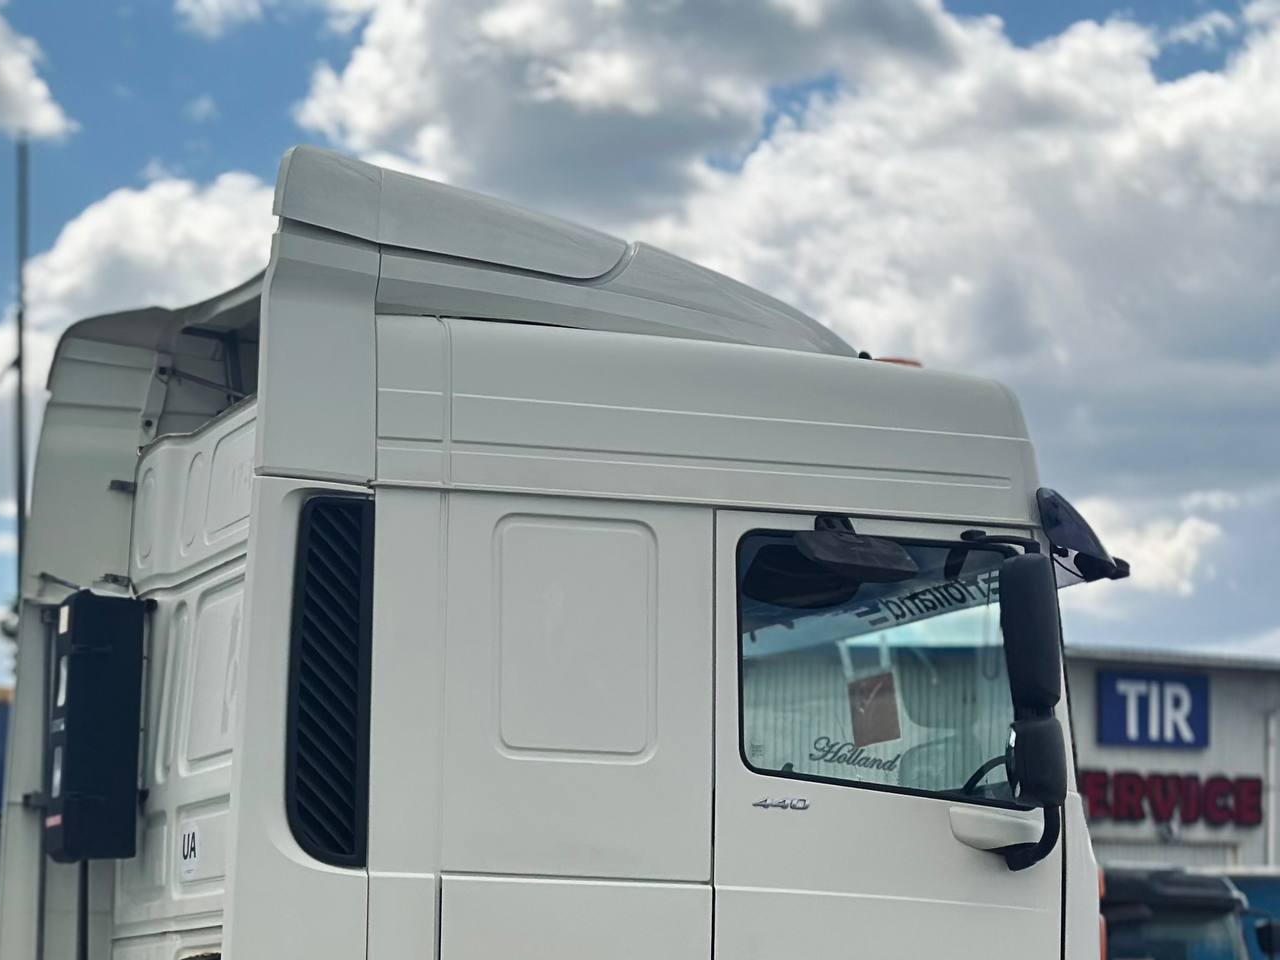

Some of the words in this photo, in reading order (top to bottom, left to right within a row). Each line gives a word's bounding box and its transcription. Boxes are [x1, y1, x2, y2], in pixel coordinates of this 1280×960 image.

[1116, 678, 1195, 743] TIR
[809, 736, 901, 772] Holland
[752, 798, 809, 810] 440
[1078, 769, 1263, 828] ERVICE
[182, 831, 197, 860] UA
